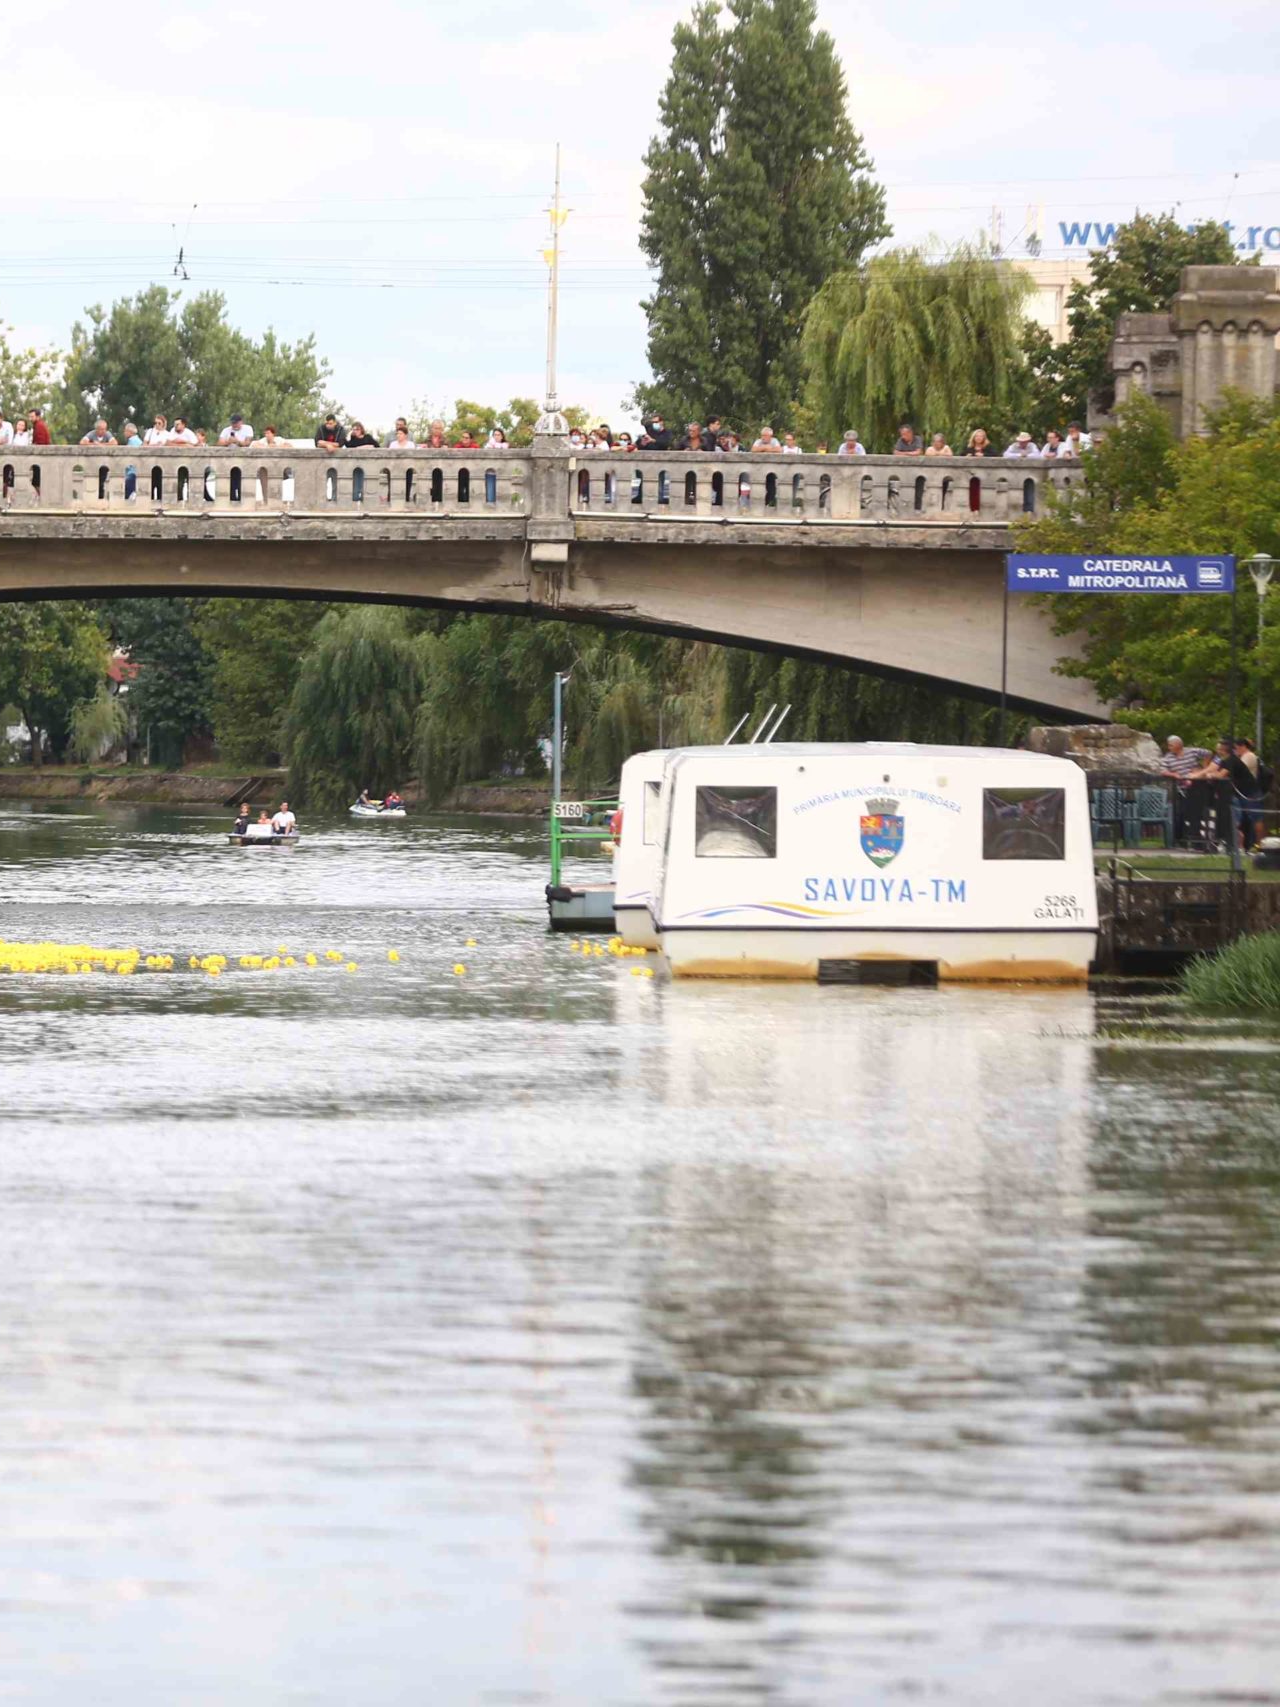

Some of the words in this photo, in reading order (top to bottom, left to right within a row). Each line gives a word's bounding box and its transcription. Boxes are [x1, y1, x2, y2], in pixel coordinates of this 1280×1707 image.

[1083, 559, 1173, 572] CATEDRALA
[1068, 574, 1188, 588] MITROPOLITANĂ
[555, 804, 581, 816] 5160
[804, 878, 966, 902] SAVOYA-TM
